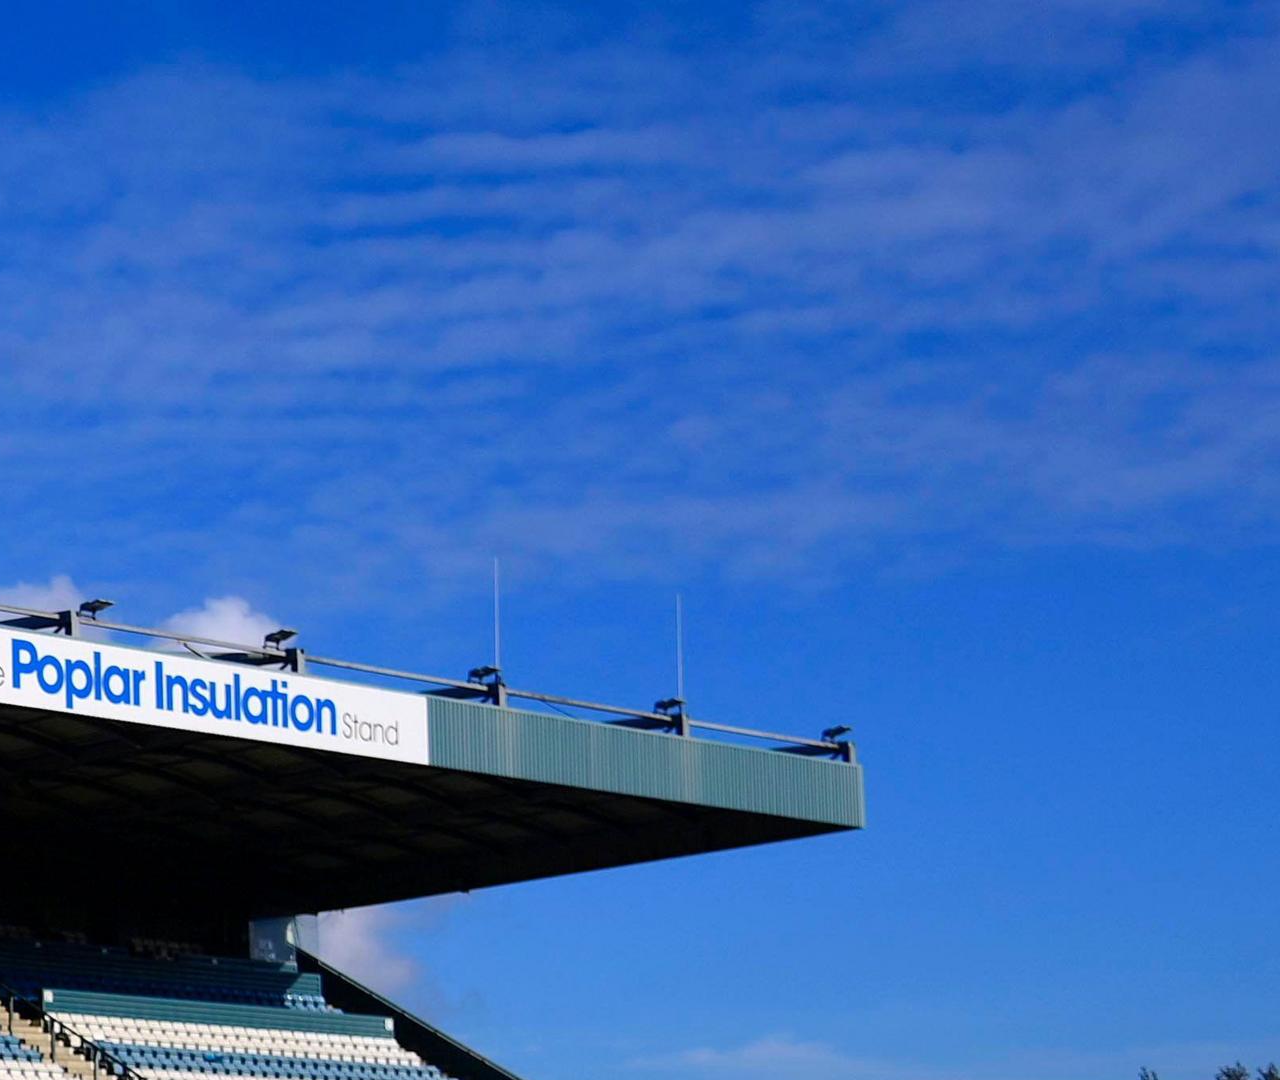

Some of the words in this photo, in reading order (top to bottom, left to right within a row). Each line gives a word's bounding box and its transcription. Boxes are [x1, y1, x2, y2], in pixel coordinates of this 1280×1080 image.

[11, 638, 147, 709] Poplar
[154, 661, 337, 736] Insulation
[342, 711, 400, 747] Stand
